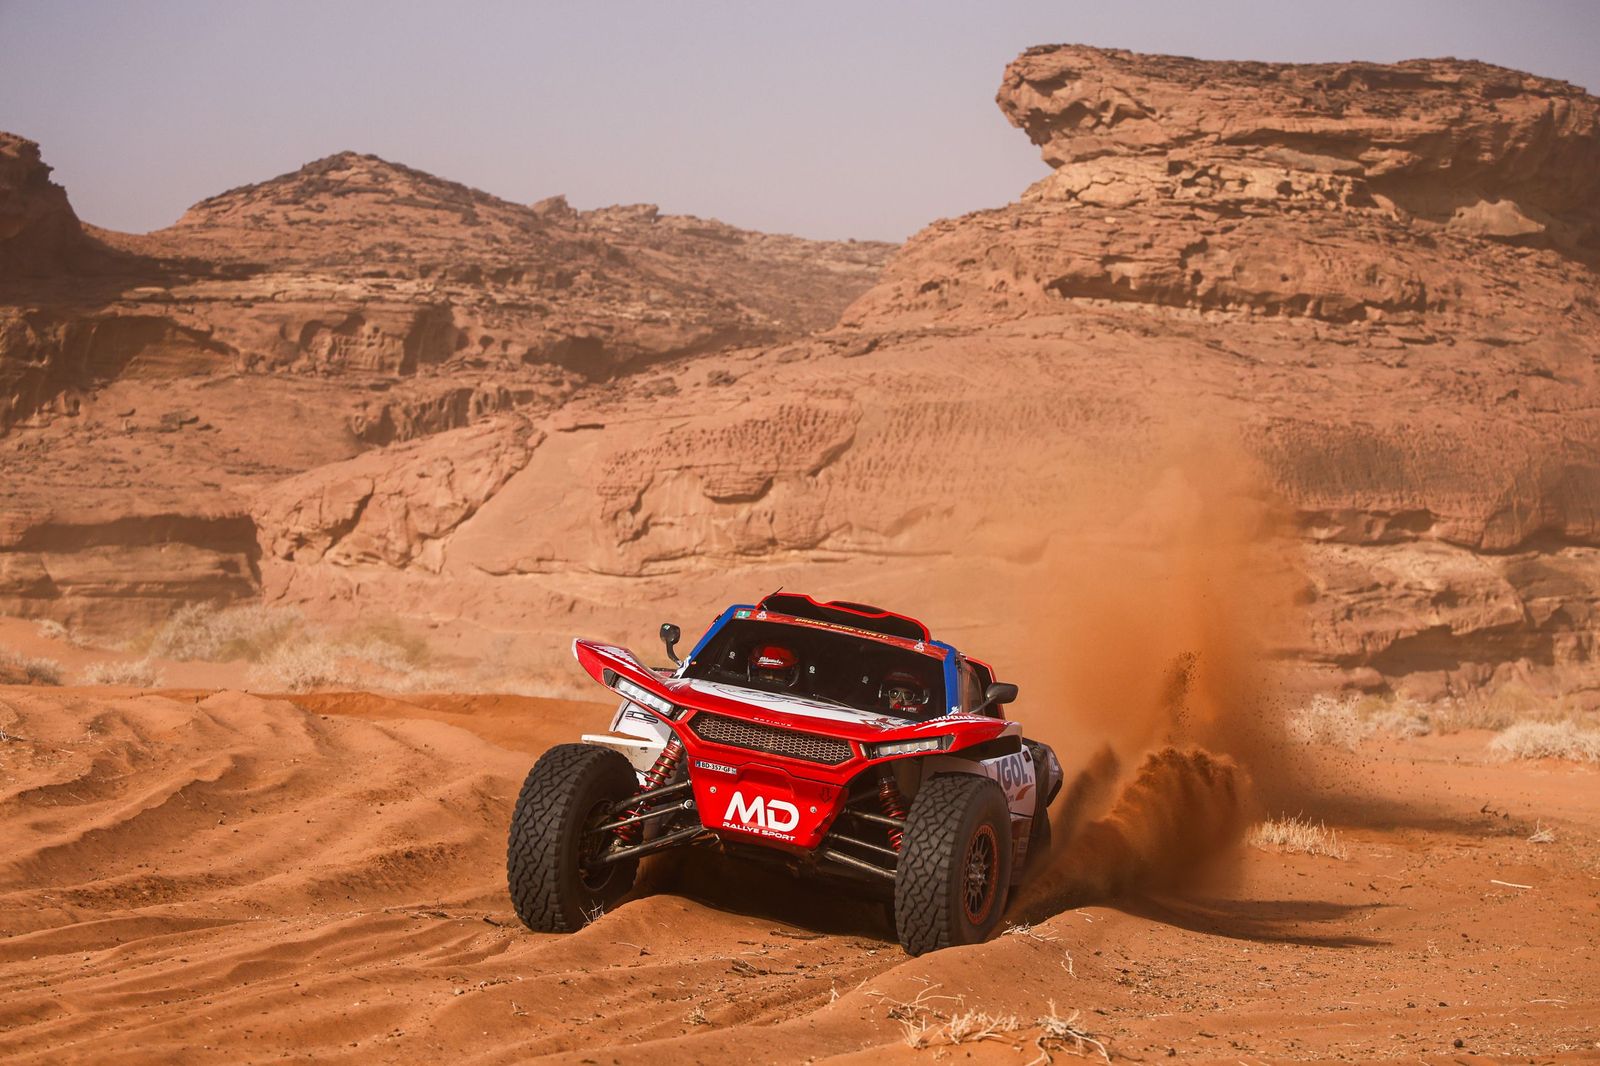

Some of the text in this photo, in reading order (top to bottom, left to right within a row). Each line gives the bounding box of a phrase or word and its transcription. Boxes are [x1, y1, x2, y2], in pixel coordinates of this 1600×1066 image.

[858, 629, 877, 637] LIVE
[701, 761, 731, 773] BD-357-GF
[996, 753, 1029, 791] IGOL
[723, 791, 800, 832] MD
[722, 821, 796, 842] RALLYE SPORT
